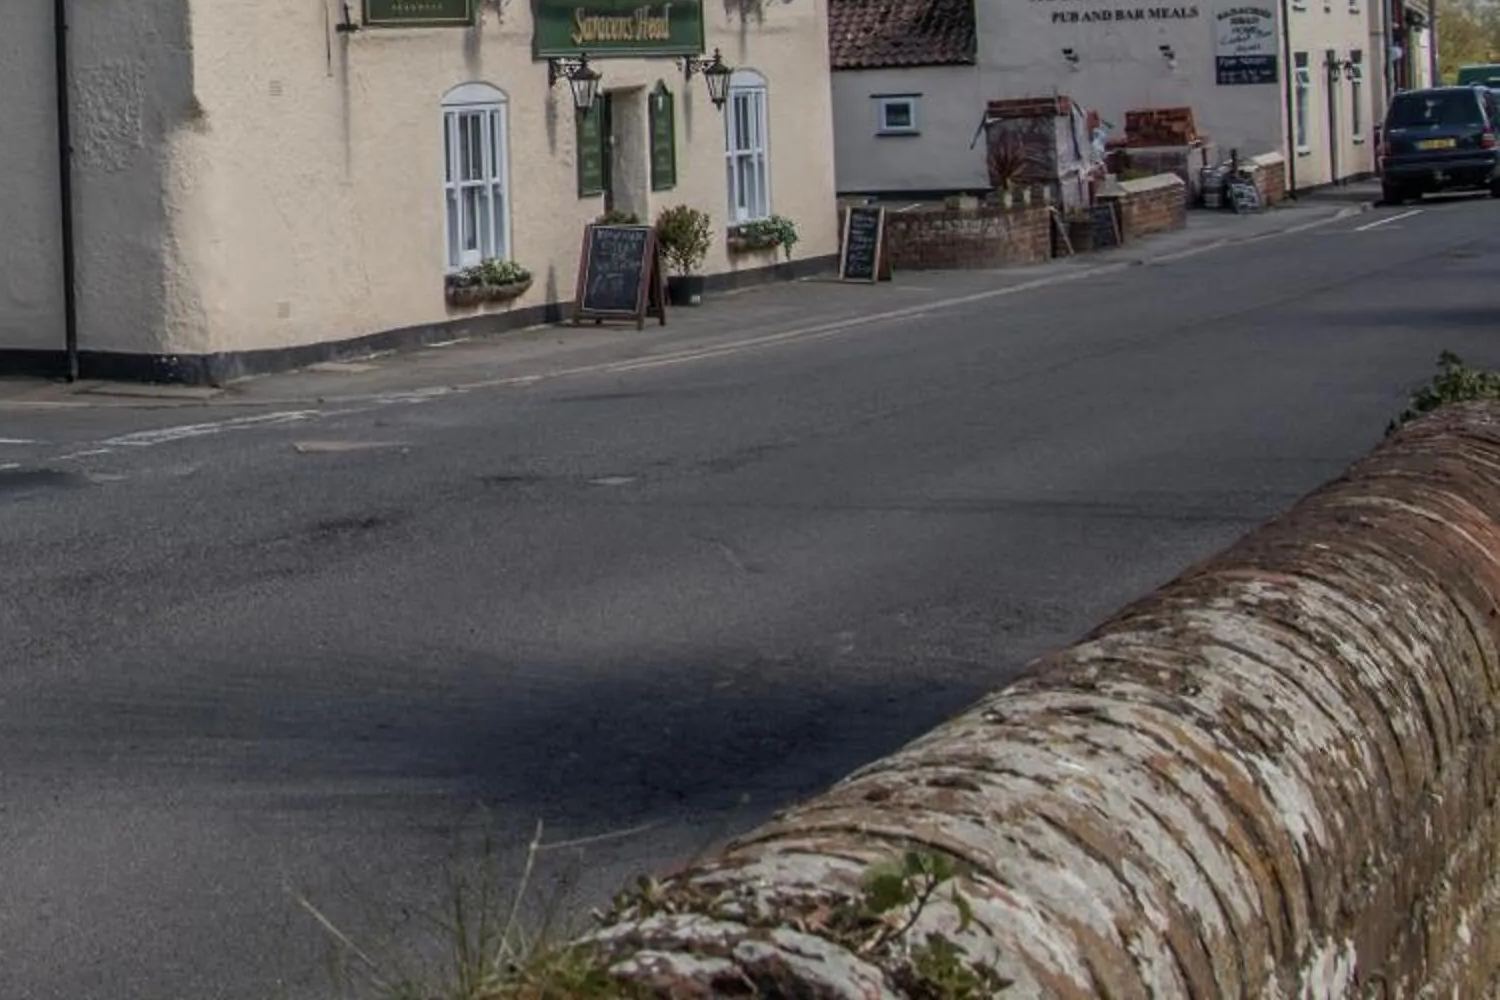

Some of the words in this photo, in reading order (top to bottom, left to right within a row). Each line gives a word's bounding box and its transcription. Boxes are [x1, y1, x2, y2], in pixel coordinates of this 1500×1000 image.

[572, 7, 633, 44] Saracens
[635, 3, 672, 40] Head
[1052, 10, 1078, 23] PUB
[1080, 9, 1112, 22] AND
[1115, 8, 1144, 21] BAR
[1148, 6, 1199, 20] MEALS
